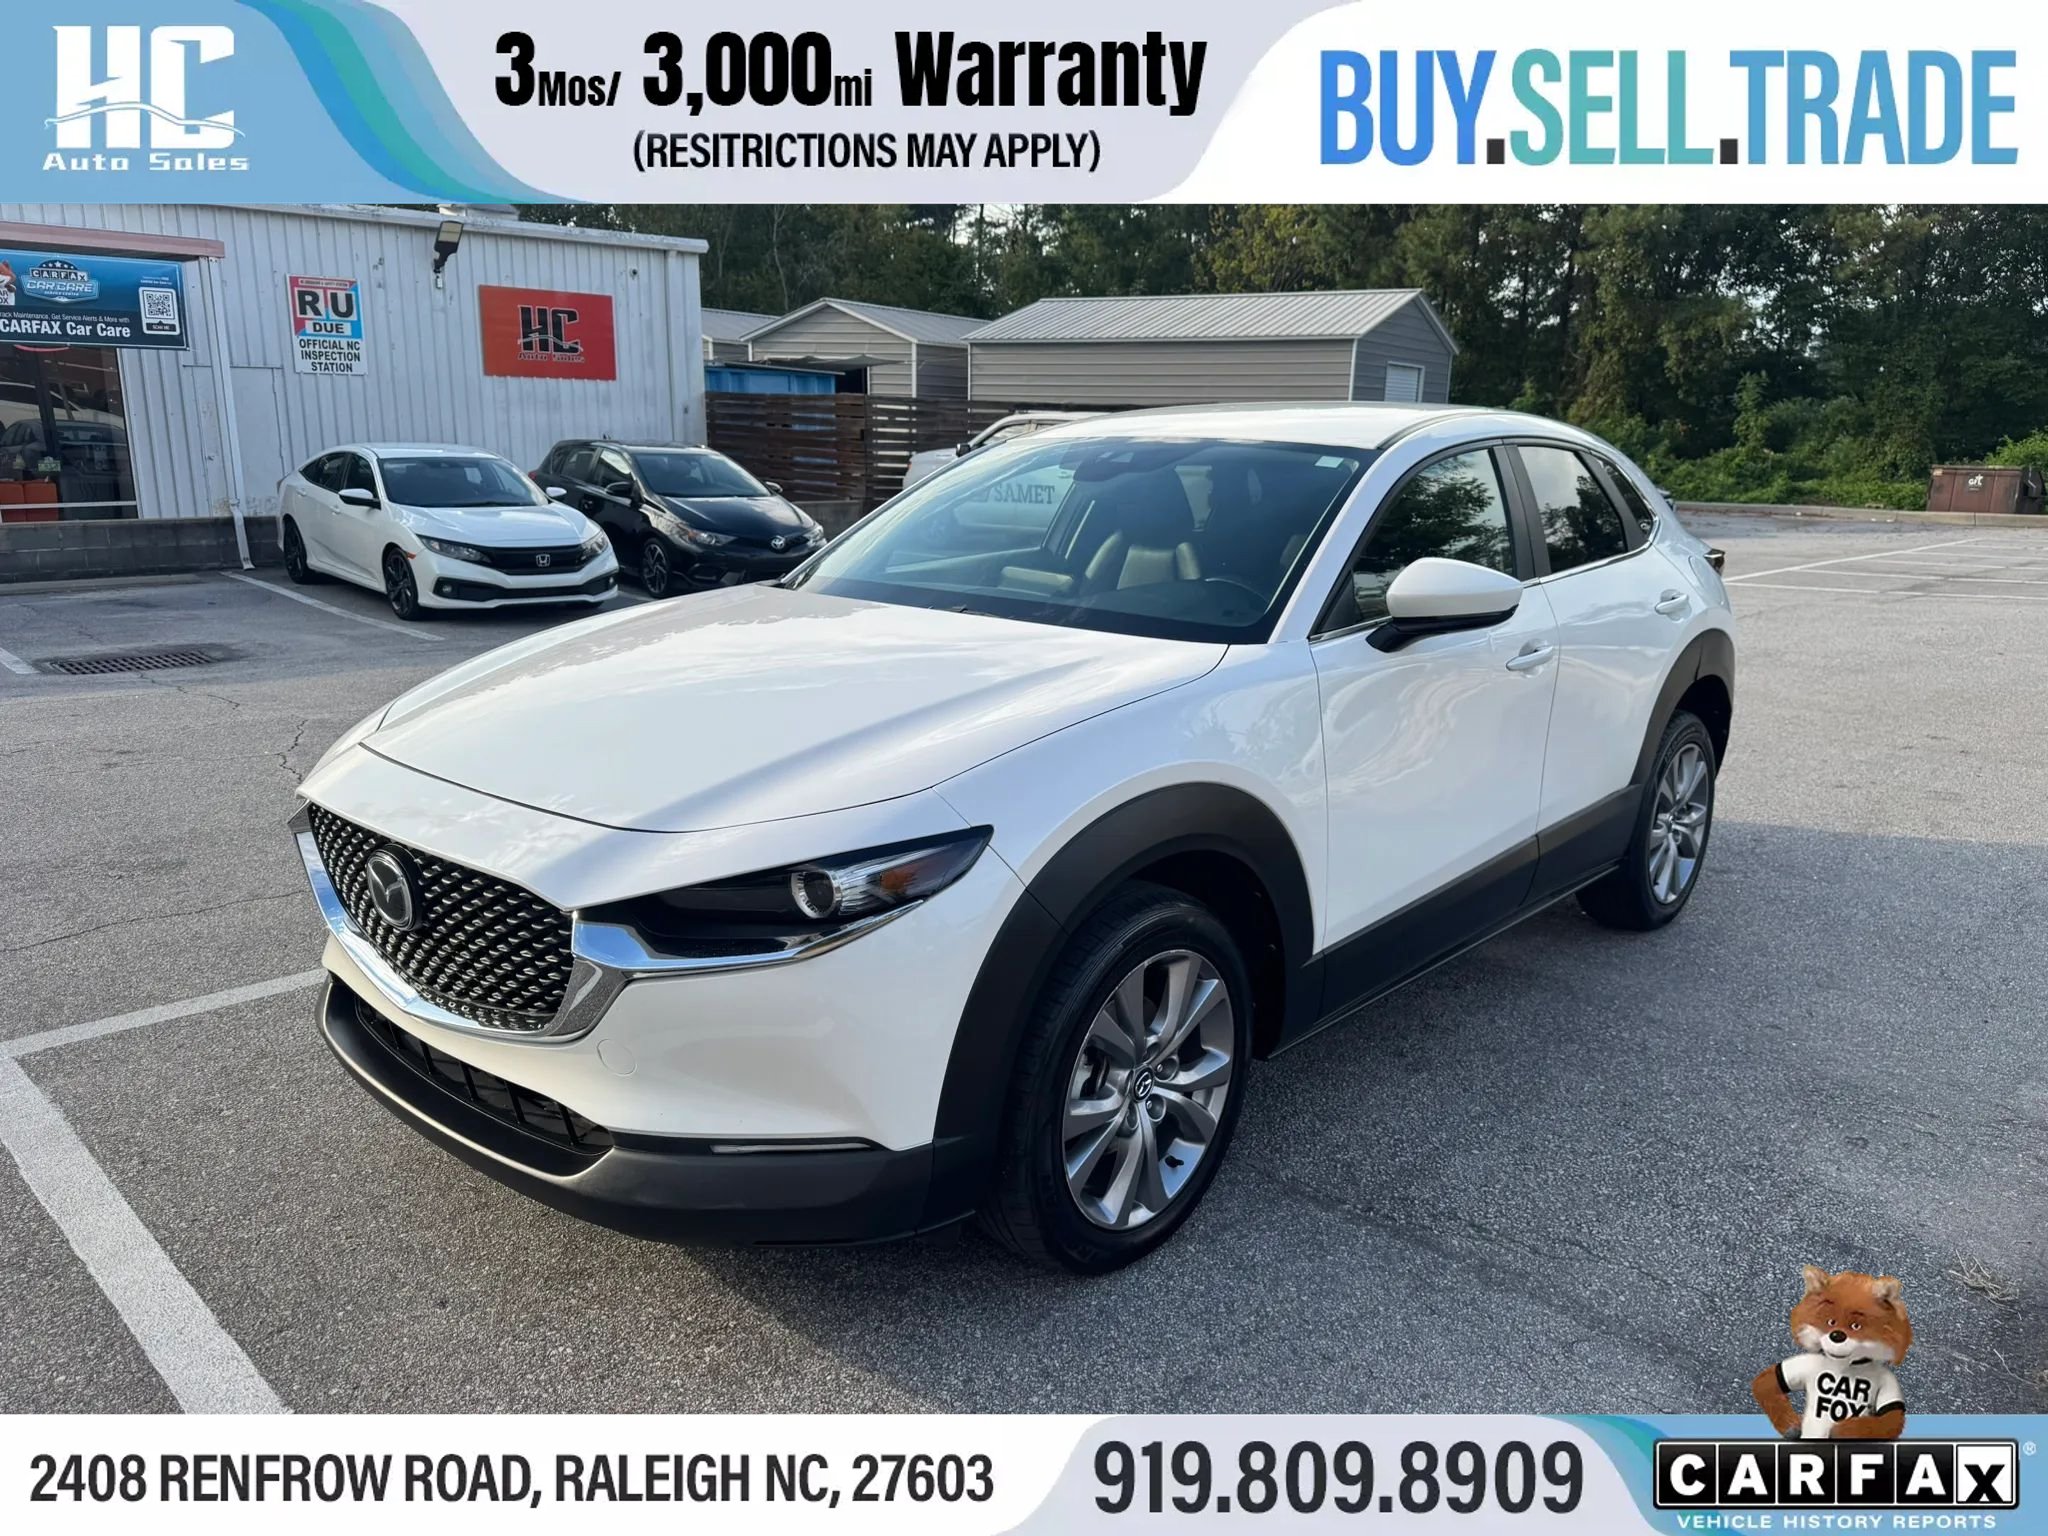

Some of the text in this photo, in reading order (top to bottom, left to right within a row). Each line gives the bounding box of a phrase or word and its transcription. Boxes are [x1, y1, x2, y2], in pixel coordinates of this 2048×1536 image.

[32, 270, 87, 281] CARFAX
[296, 289, 354, 318] R U
[0, 318, 131, 338] CARFAX Car Care
[312, 321, 345, 334] DUE
[519, 304, 581, 355] HC
[299, 338, 361, 351] OFFICIAL NC
[300, 350, 361, 362] INSPECTION
[311, 361, 353, 372] STATION
[993, 482, 1055, 505] SAMET
